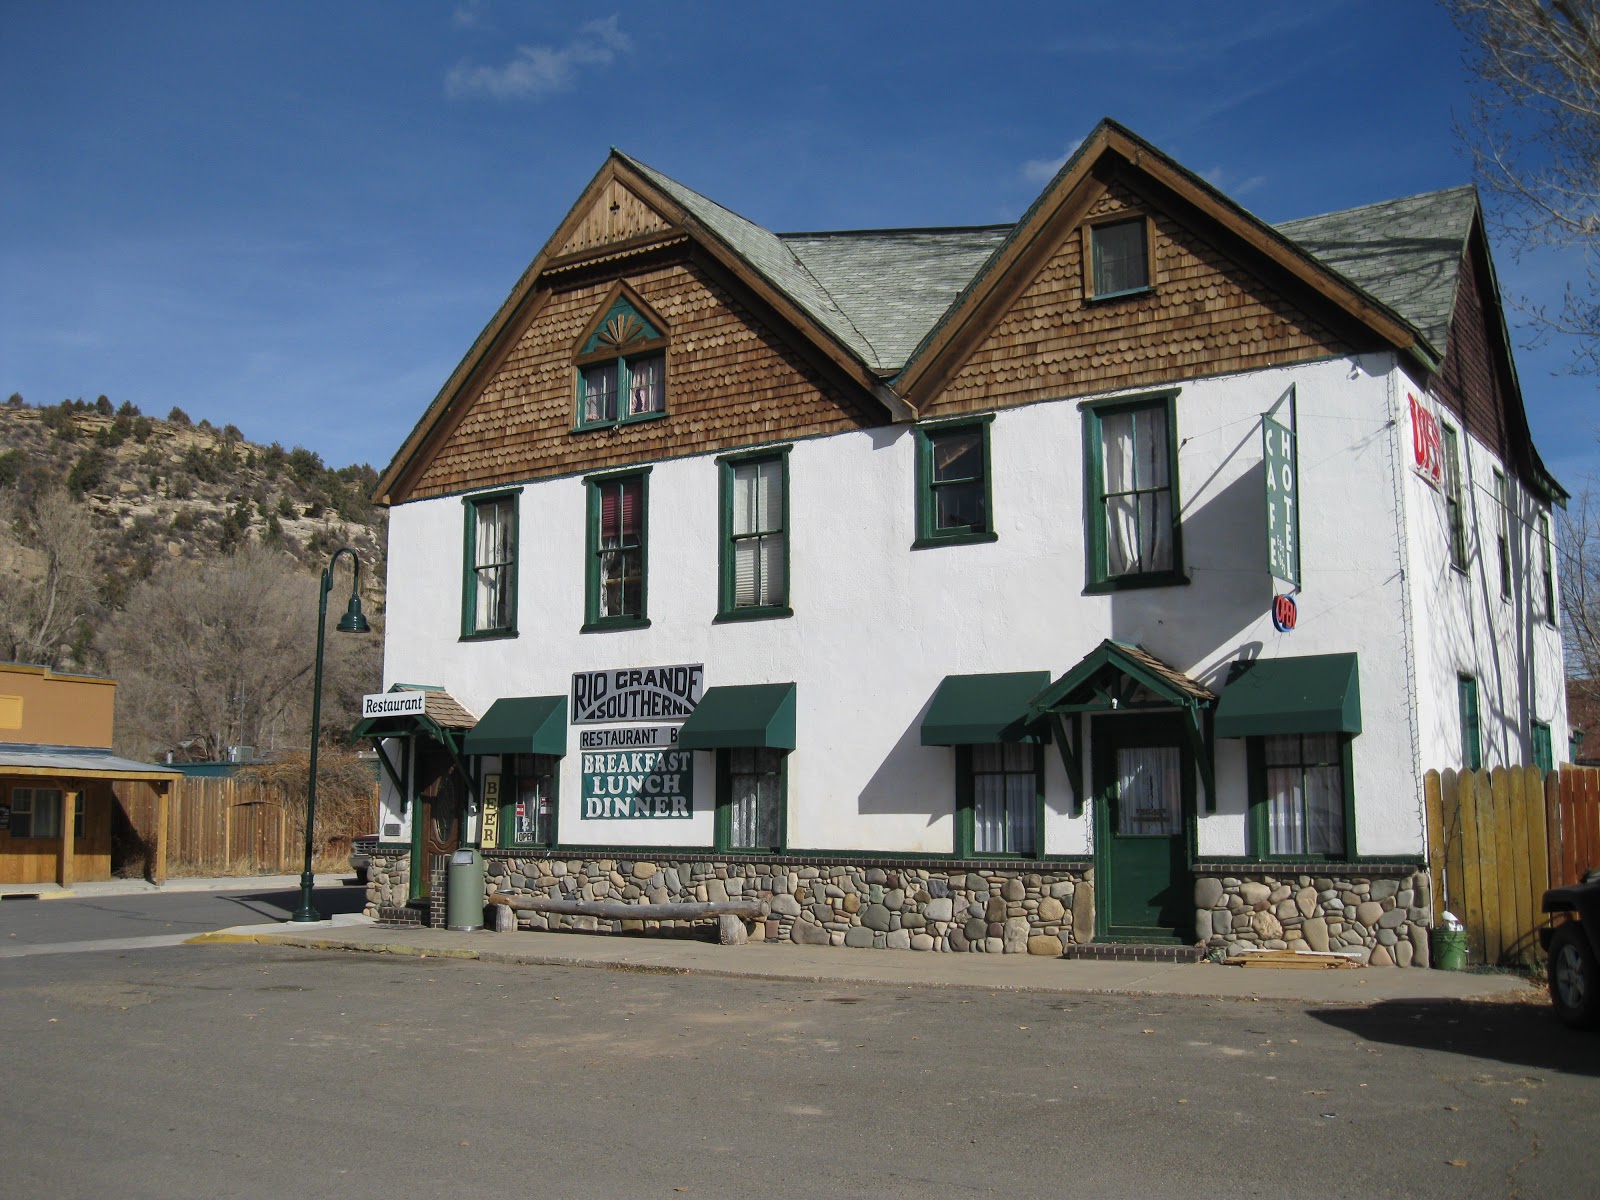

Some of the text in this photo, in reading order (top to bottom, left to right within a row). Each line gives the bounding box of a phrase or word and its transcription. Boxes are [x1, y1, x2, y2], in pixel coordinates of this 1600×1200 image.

[1265, 428, 1277, 567] CAFE
[1281, 431, 1293, 580] HOTEL
[1277, 594, 1297, 628] OPEN
[366, 696, 422, 714] Restaurant
[575, 668, 703, 721] RIO GRANDE
[597, 690, 684, 719] SOUTHERN
[582, 728, 659, 747] RESTAURANT
[584, 752, 691, 774] BREAKFAST
[592, 774, 681, 795] LUNCH
[484, 782, 497, 841] BEER
[586, 796, 689, 818] DINNER
